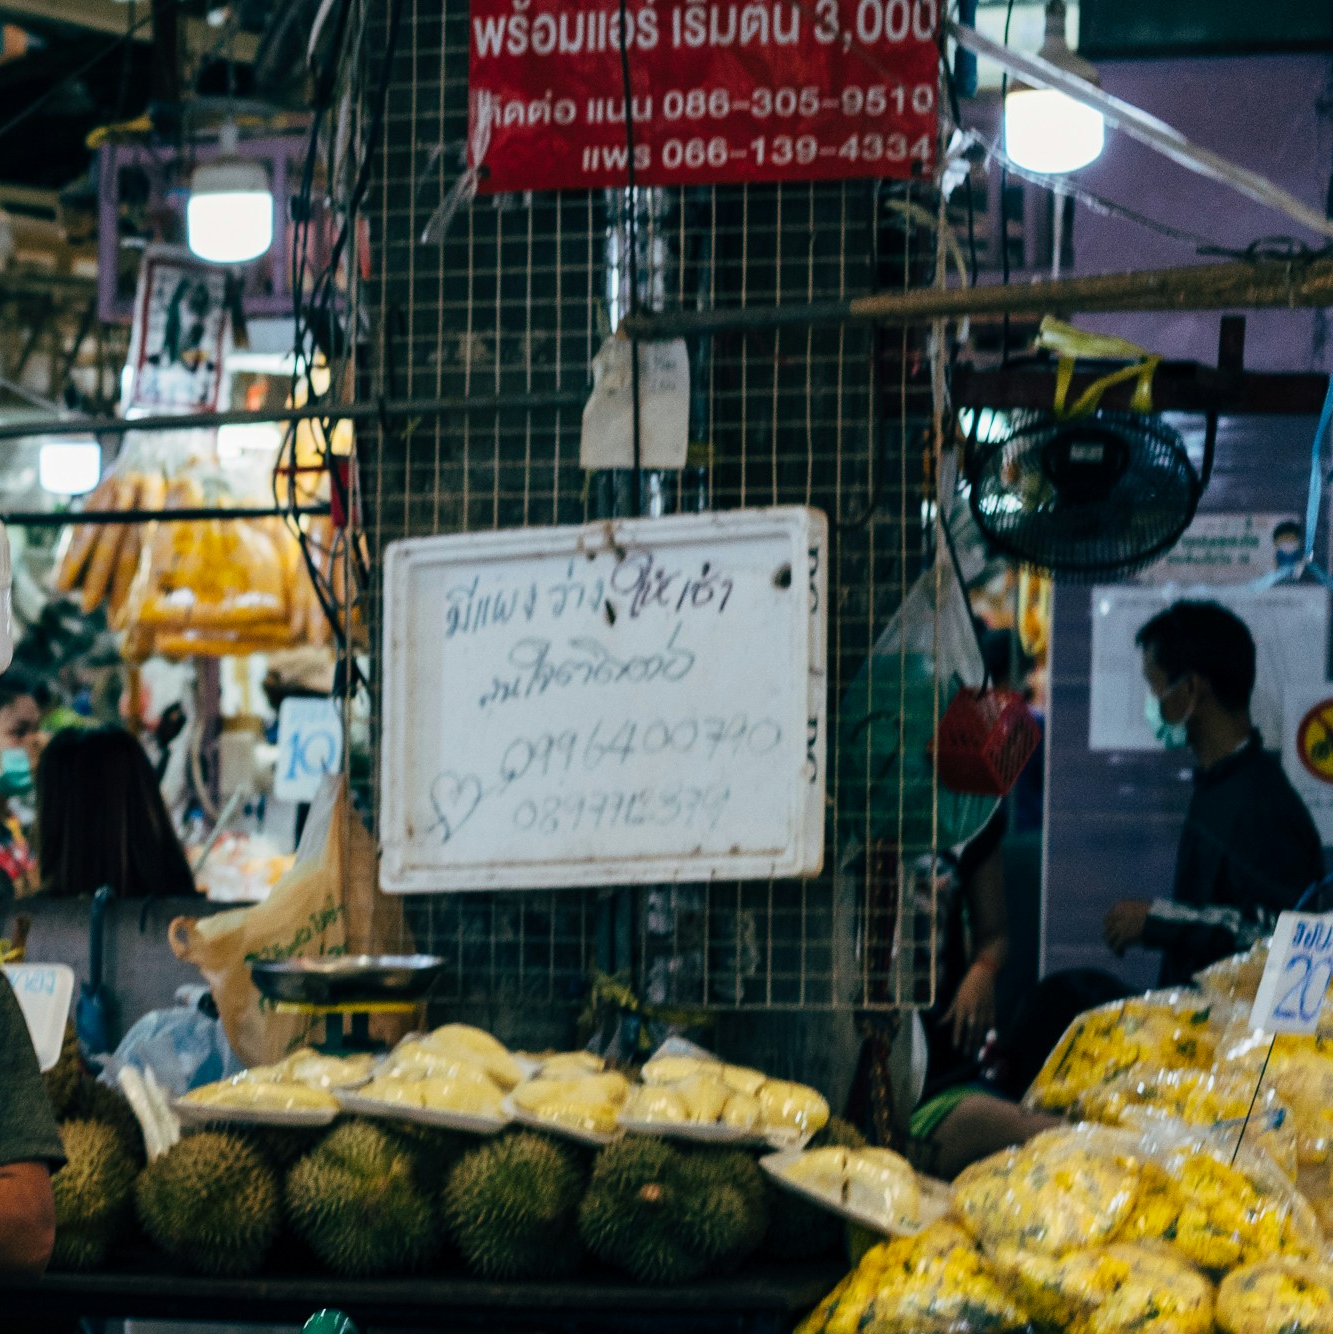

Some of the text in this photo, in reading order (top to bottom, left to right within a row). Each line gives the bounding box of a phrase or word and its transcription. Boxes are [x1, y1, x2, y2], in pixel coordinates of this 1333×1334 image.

[813, 0, 937, 54] 3,000
[662, 83, 934, 121] 086-305-9510
[661, 131, 933, 169] 066-139-4334
